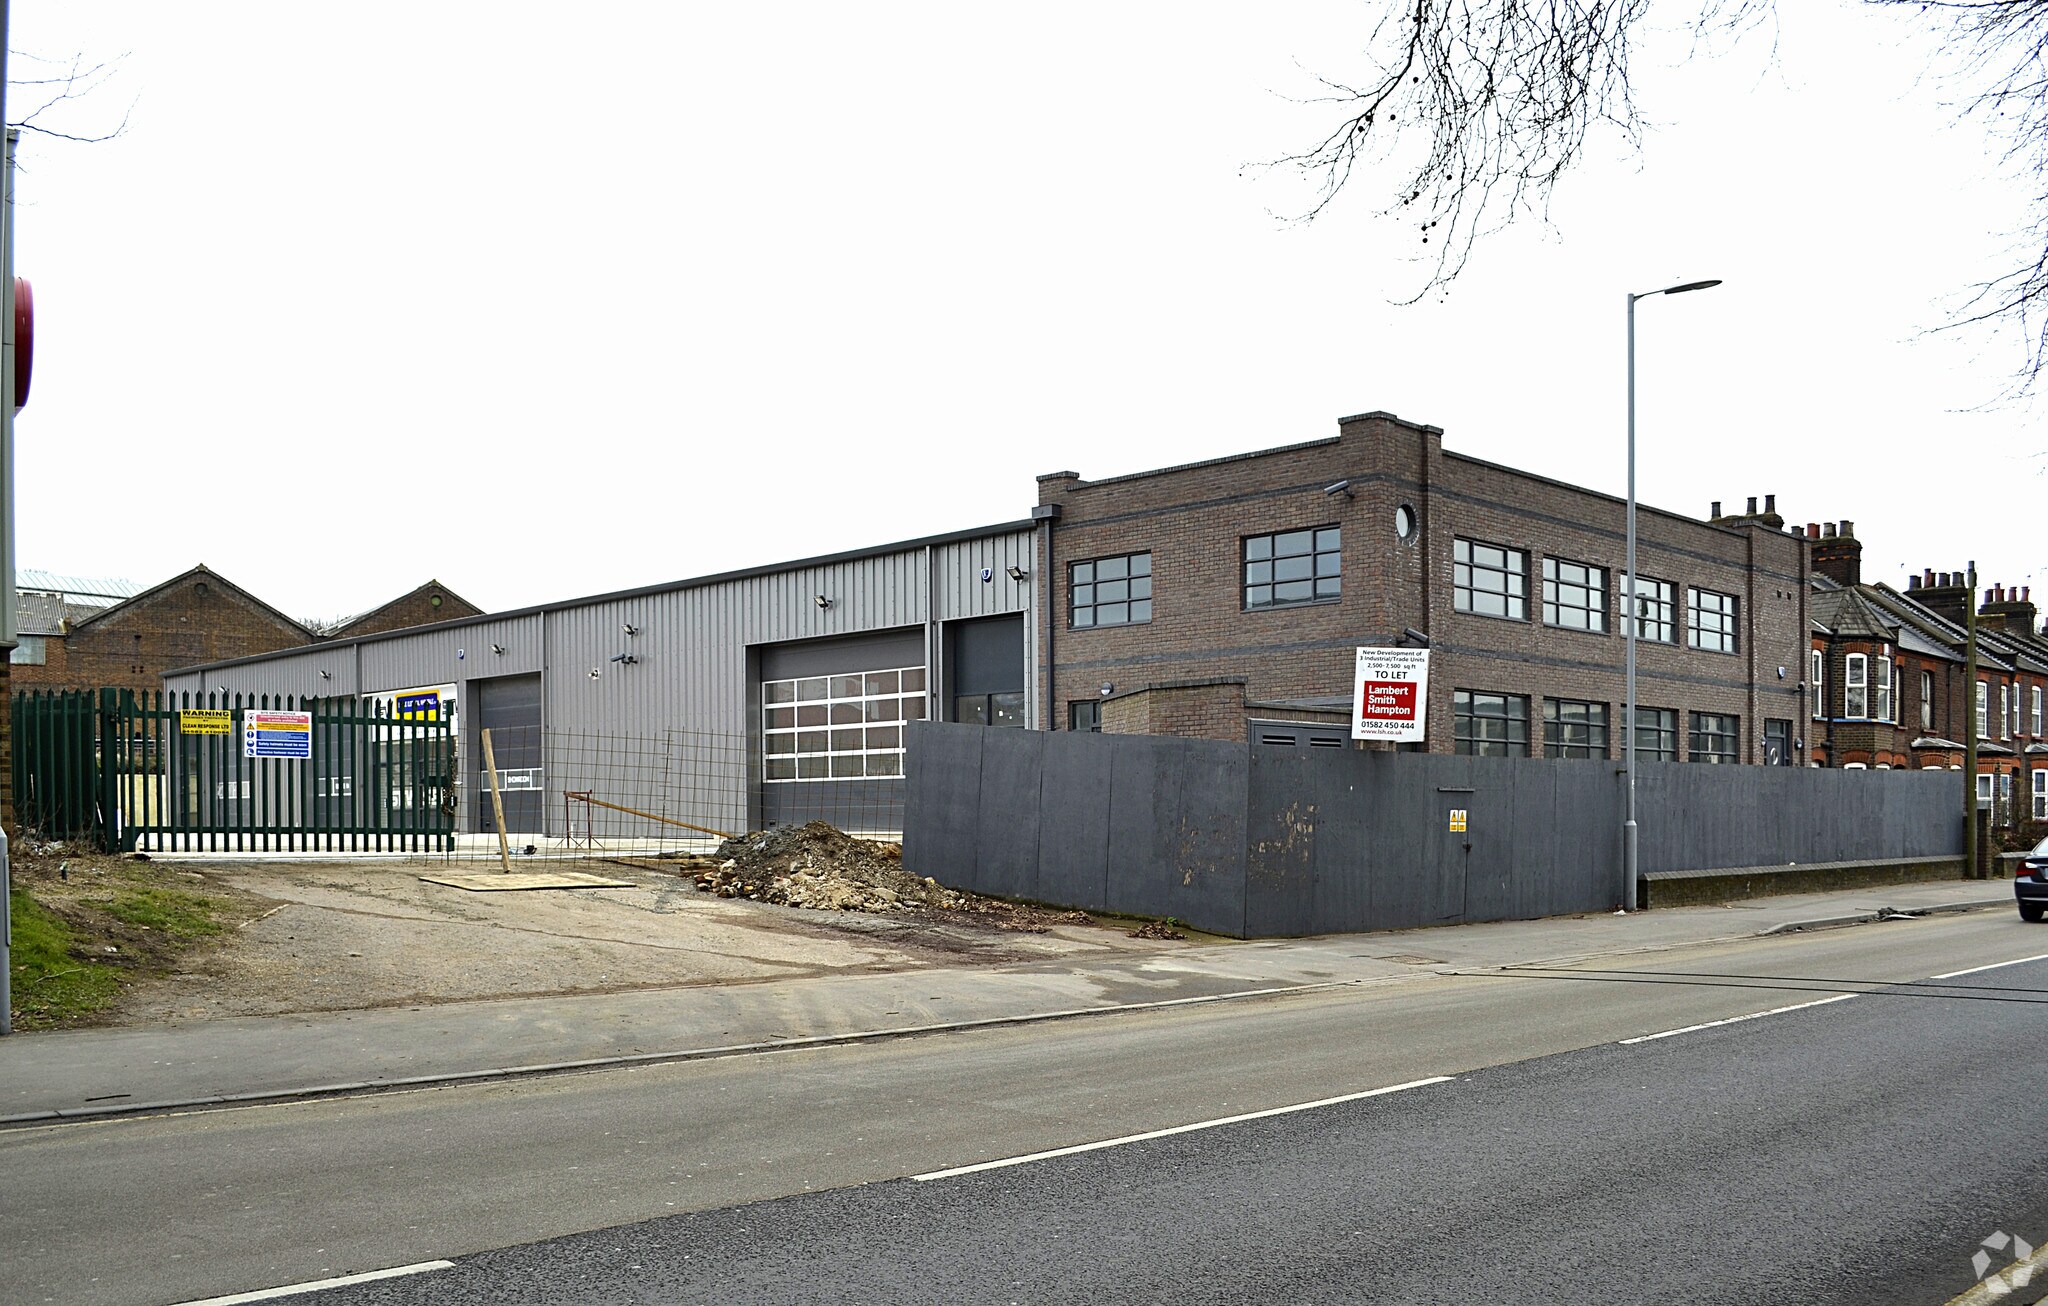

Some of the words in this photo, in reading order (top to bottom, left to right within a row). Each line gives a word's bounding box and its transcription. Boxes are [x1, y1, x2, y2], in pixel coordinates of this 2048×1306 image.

[1375, 670, 1388, 678] TO
[1392, 671, 1408, 679] LET
[1368, 685, 1408, 695] Lambert
[1368, 695, 1396, 704] Smith
[1368, 704, 1410, 716] Hampton
